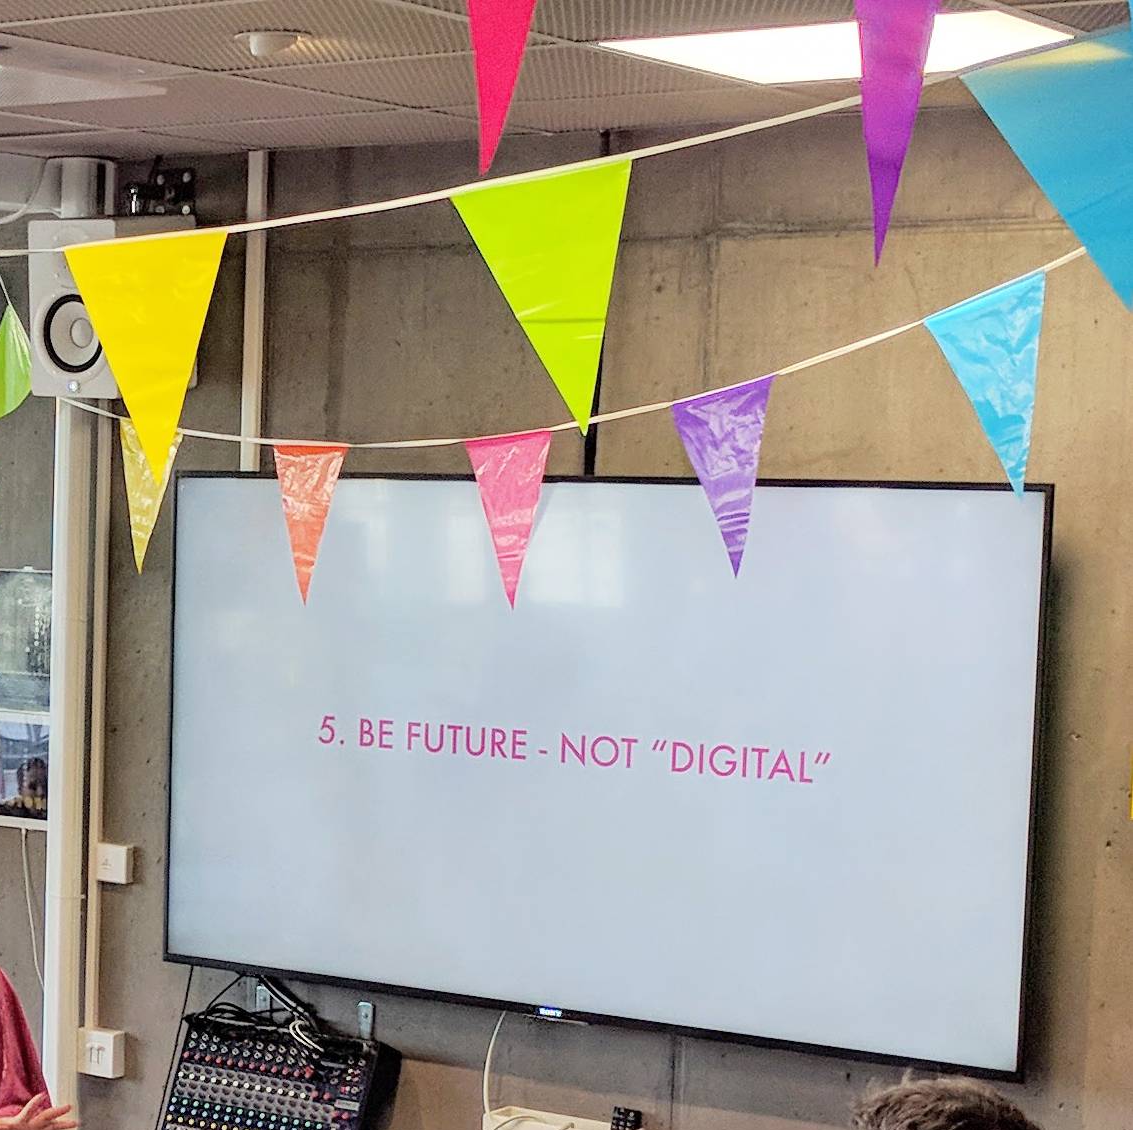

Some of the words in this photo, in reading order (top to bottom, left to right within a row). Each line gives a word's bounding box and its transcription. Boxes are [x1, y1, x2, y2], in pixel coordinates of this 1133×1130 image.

[319, 713, 345, 746] 5.
[358, 718, 393, 751] BE
[407, 722, 528, 762] FUTURE
[560, 733, 638, 769] NOT
[652, 740, 832, 785] “DIGITAL”
